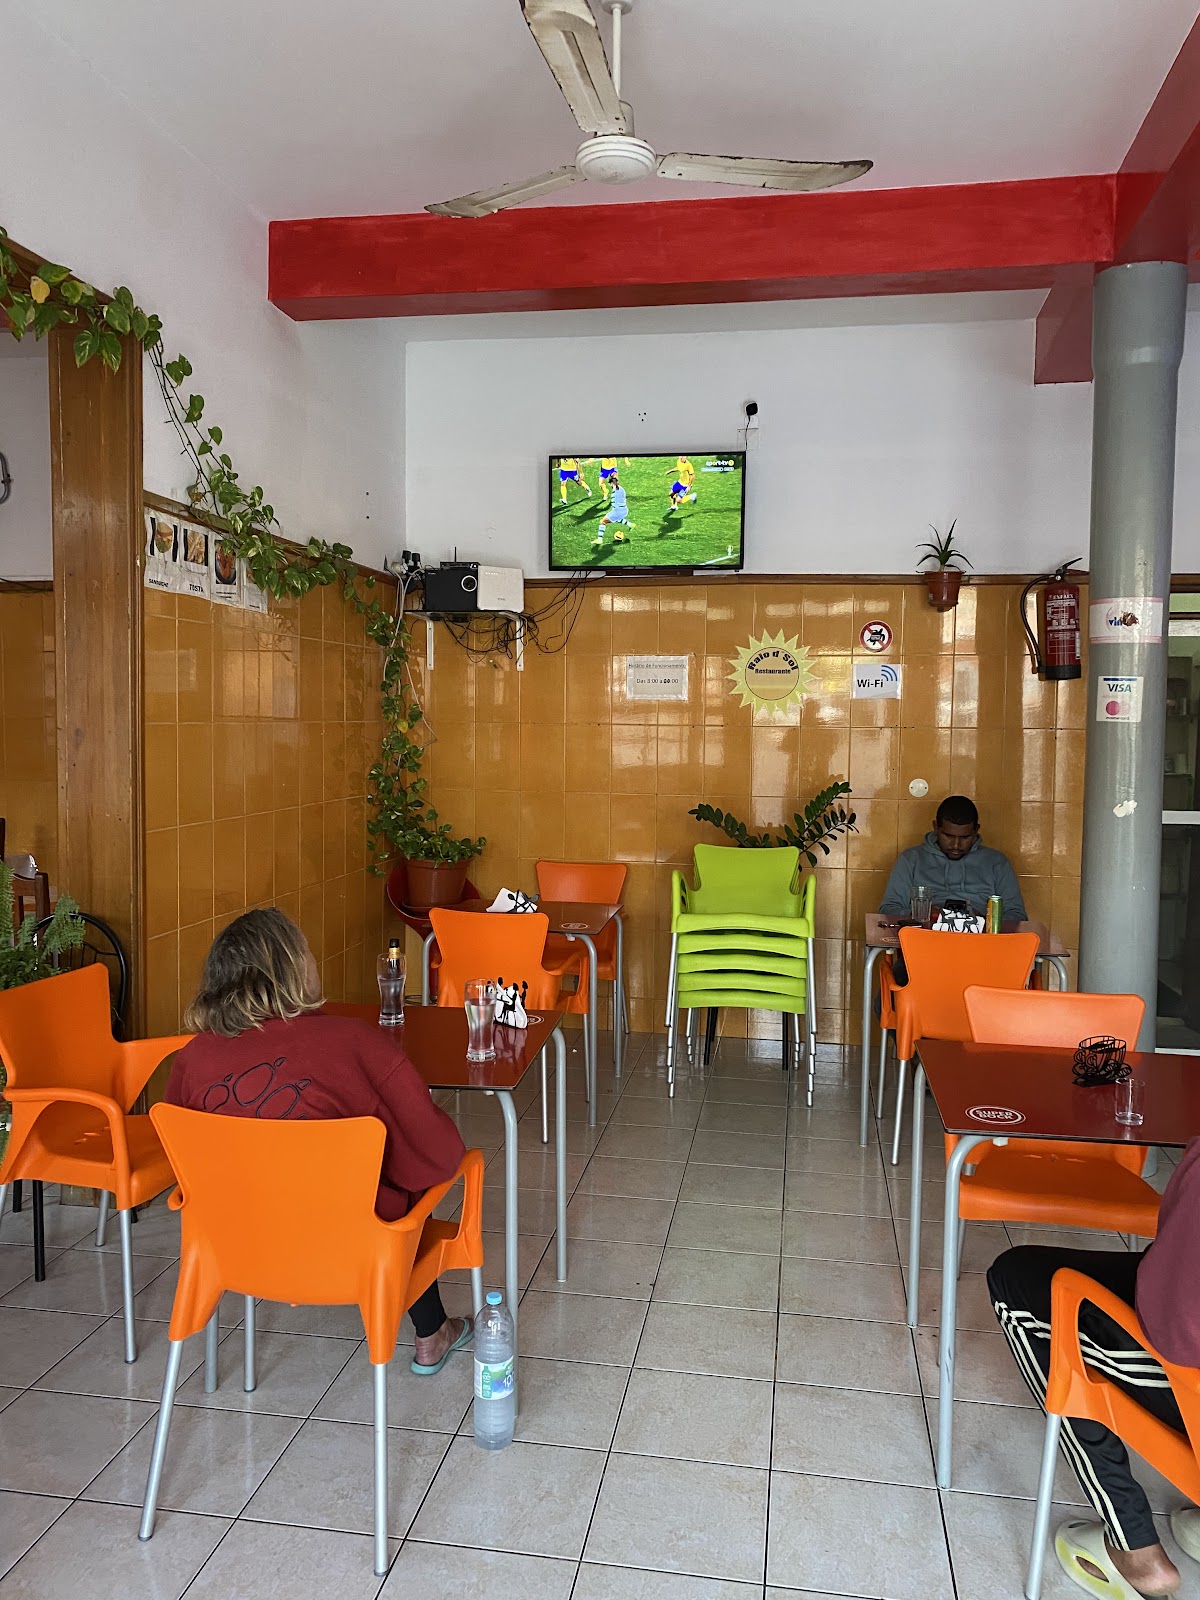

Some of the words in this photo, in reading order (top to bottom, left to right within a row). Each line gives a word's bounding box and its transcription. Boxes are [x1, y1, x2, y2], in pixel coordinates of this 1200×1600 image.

[747, 651, 770, 671] Raio
[857, 679, 884, 688] Wi-Fi
[1107, 683, 1132, 692] VISA
